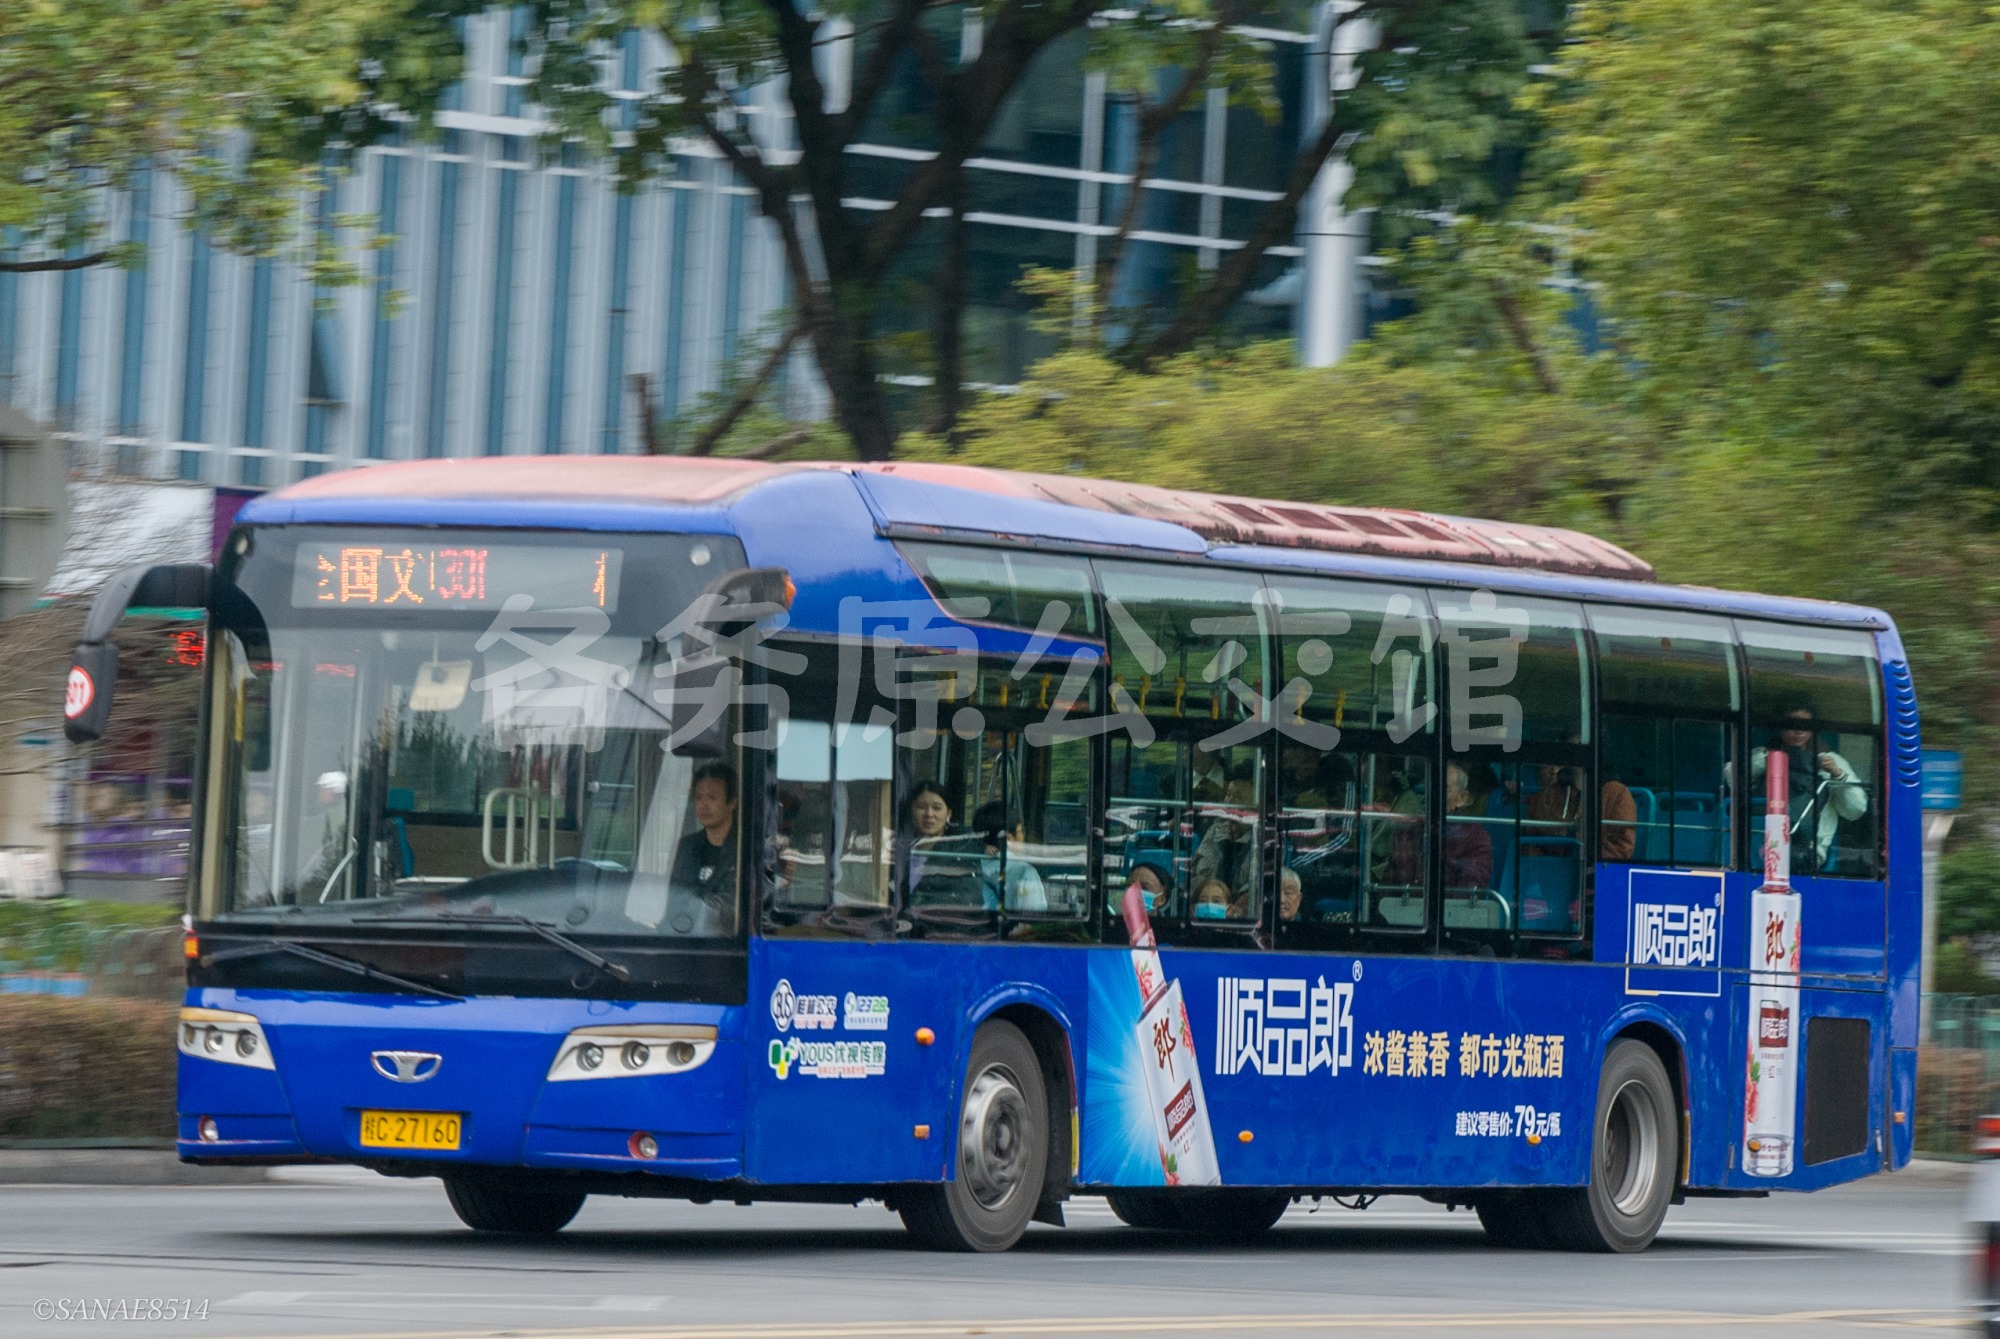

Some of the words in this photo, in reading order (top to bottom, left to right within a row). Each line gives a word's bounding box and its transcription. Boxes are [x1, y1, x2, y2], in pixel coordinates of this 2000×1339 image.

[1633, 902, 1717, 967] 顺品郎
[1215, 974, 1354, 1077] 顺品郎
[1362, 1030, 1450, 1078] 浓酱兼香
[1459, 1031, 1565, 1079] 都市光瓶酒
